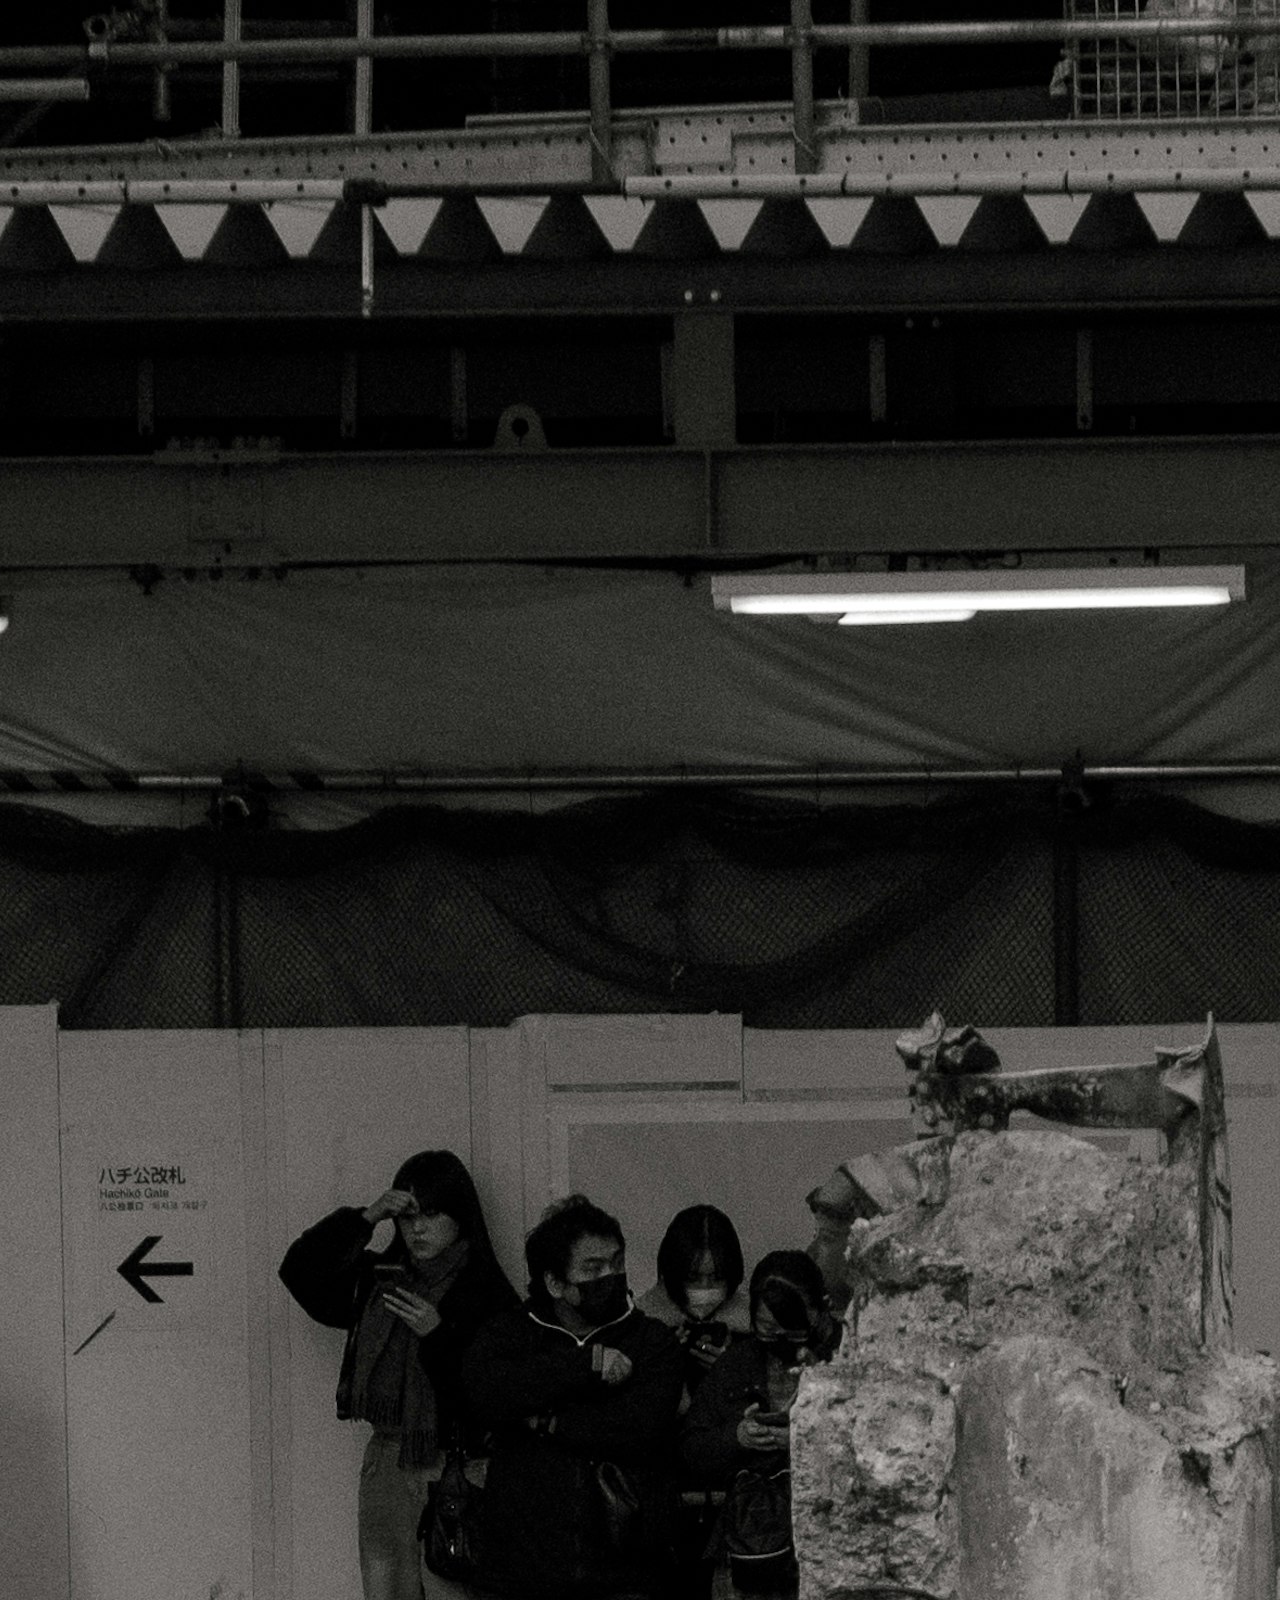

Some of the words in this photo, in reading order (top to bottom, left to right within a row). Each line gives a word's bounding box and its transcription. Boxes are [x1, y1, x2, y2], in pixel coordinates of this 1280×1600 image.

[98, 1165, 186, 1185] ハチ公改札
[144, 1187, 170, 1199] Gate
